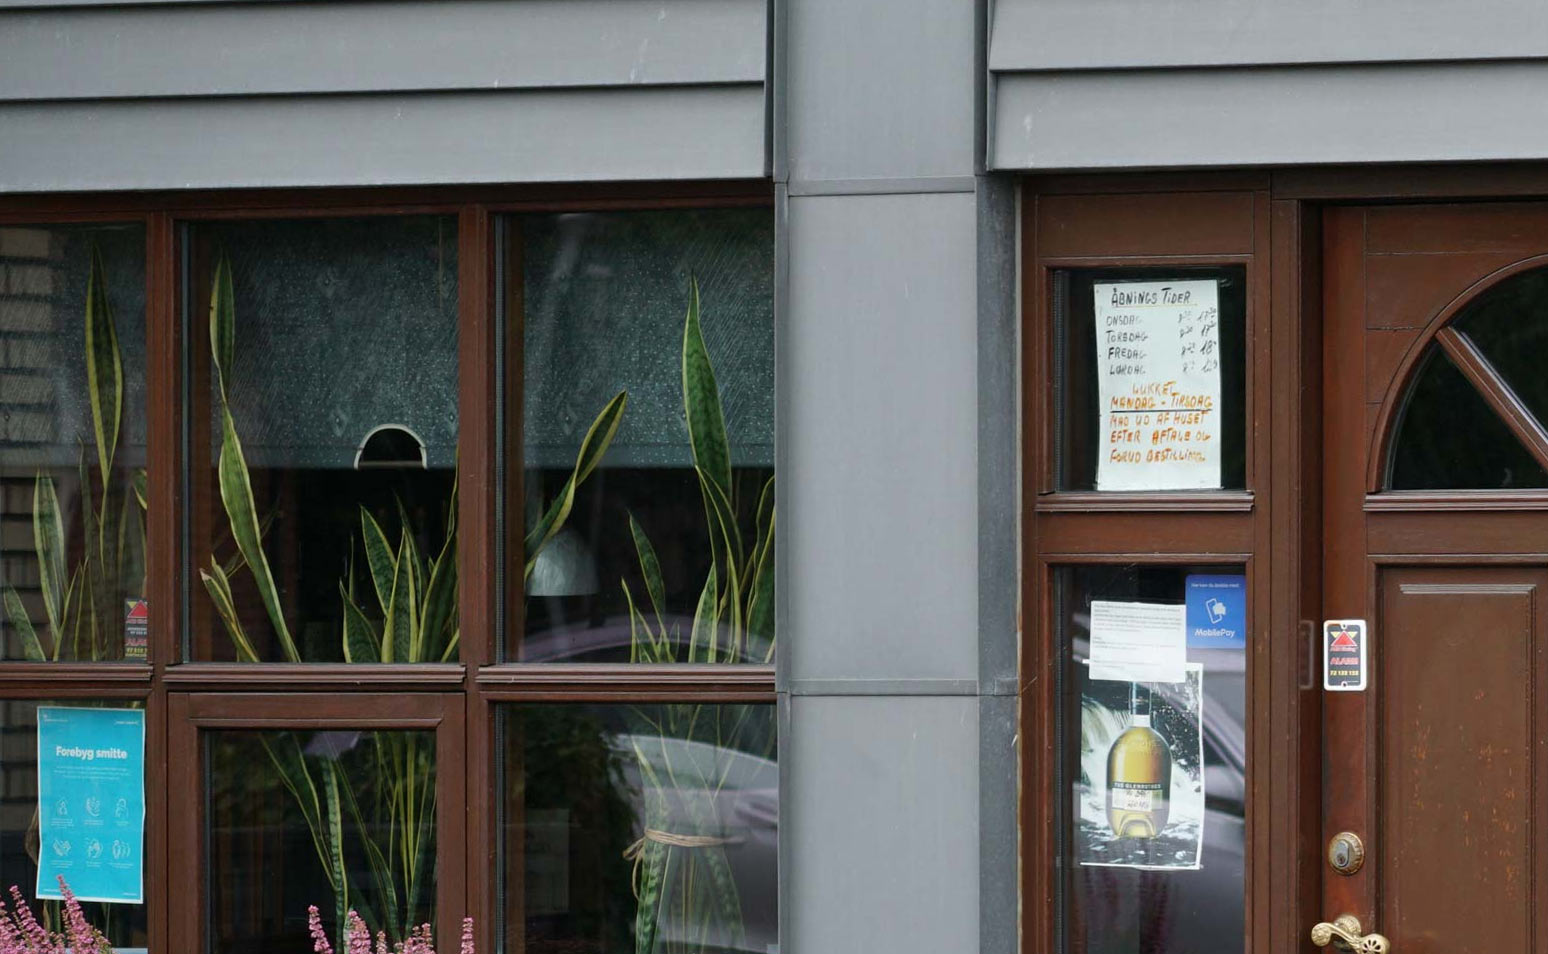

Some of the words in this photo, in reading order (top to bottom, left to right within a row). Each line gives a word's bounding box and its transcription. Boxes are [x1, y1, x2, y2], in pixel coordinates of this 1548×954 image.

[1106, 330, 1148, 344] TORSDAG
[1108, 347, 1147, 359] FREDAG
[1133, 381, 1176, 396] LUKKET
[1110, 415, 1129, 427] MAD
[1136, 415, 1150, 425] UD
[1157, 412, 1169, 425] AF
[1173, 409, 1209, 425] HUSET
[1110, 429, 1140, 443] EFTER
[1152, 427, 1191, 445] AFTALE
[1110, 448, 1141, 463] FORUD
[1194, 628, 1236, 638] MobilePay
[56, 746, 94, 760] Forebyg
[96, 747, 128, 759] smitte
